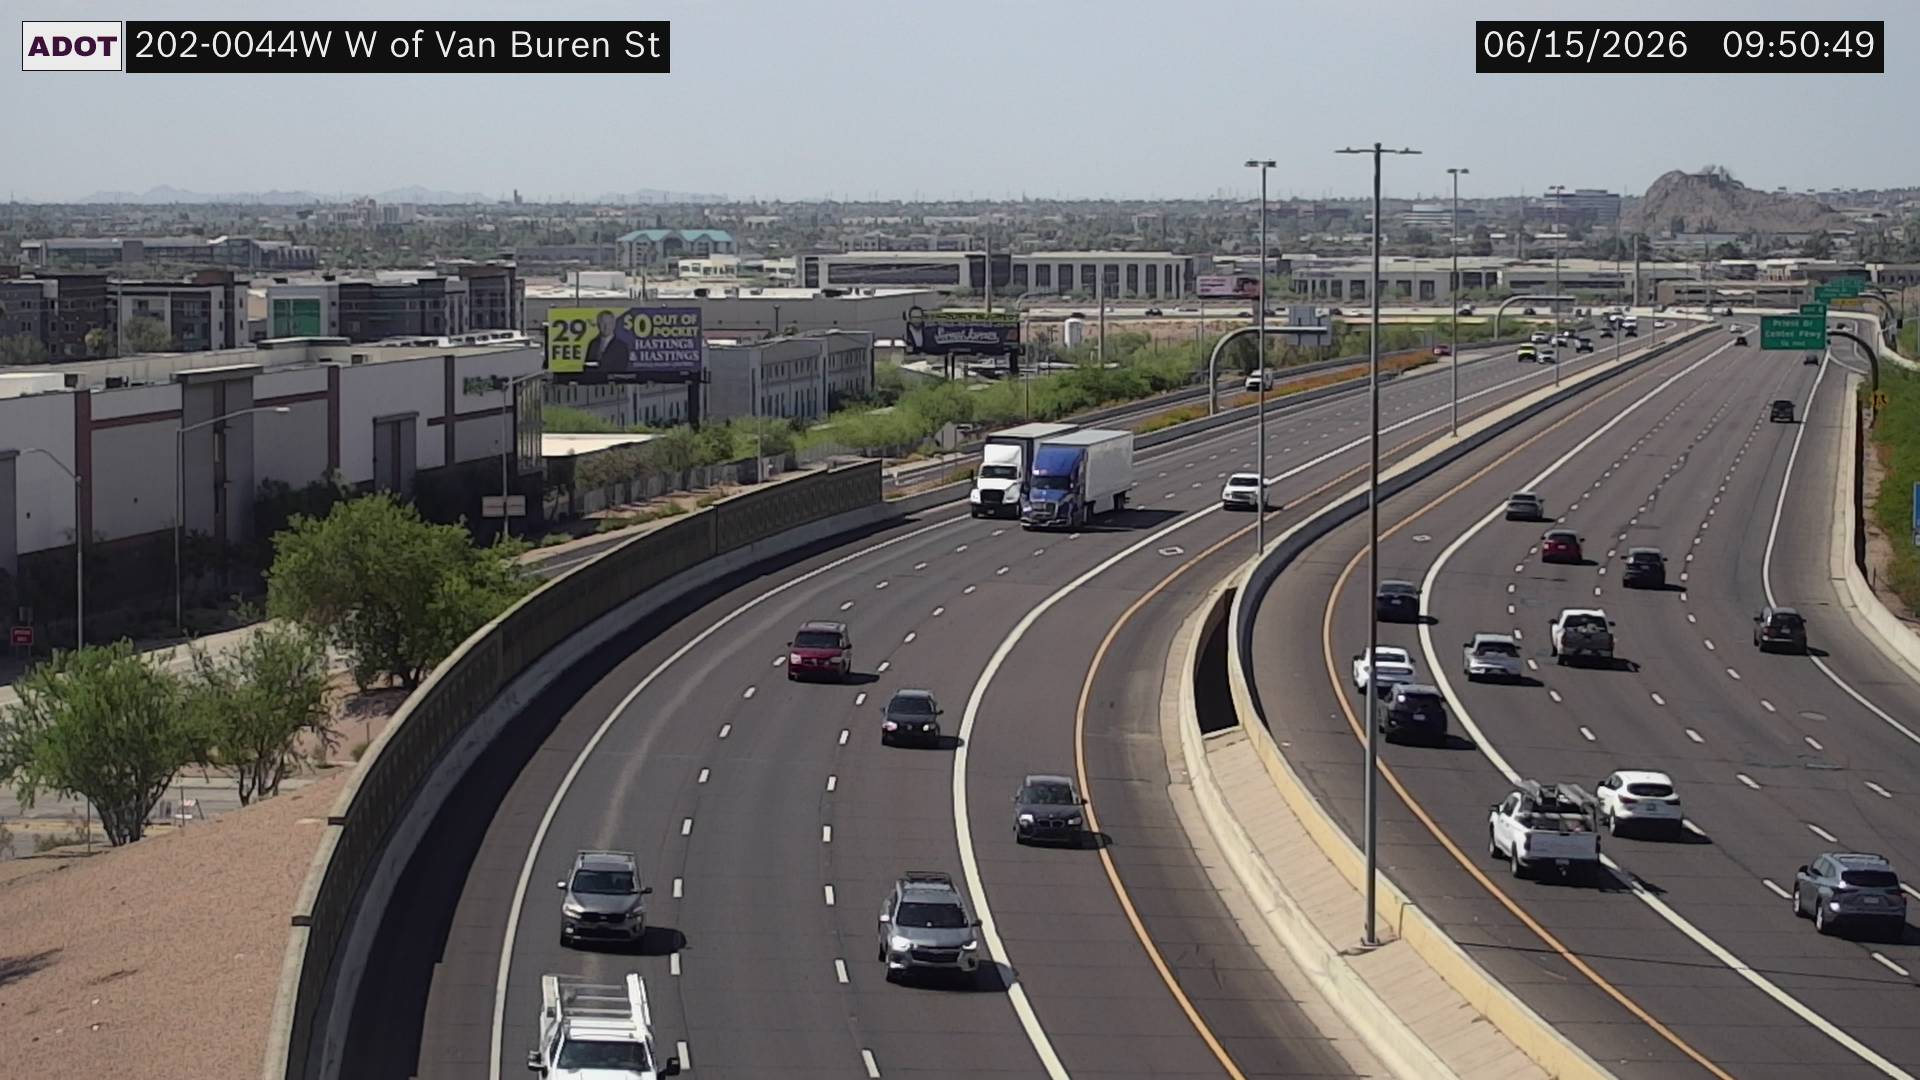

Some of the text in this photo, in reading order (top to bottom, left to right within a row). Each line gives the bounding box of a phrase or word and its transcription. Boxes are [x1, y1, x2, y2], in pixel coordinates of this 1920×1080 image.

[623, 313, 652, 338] $0
[652, 314, 678, 326] OUT
[551, 344, 582, 360] FEE
[639, 350, 700, 361] HASTINGS
